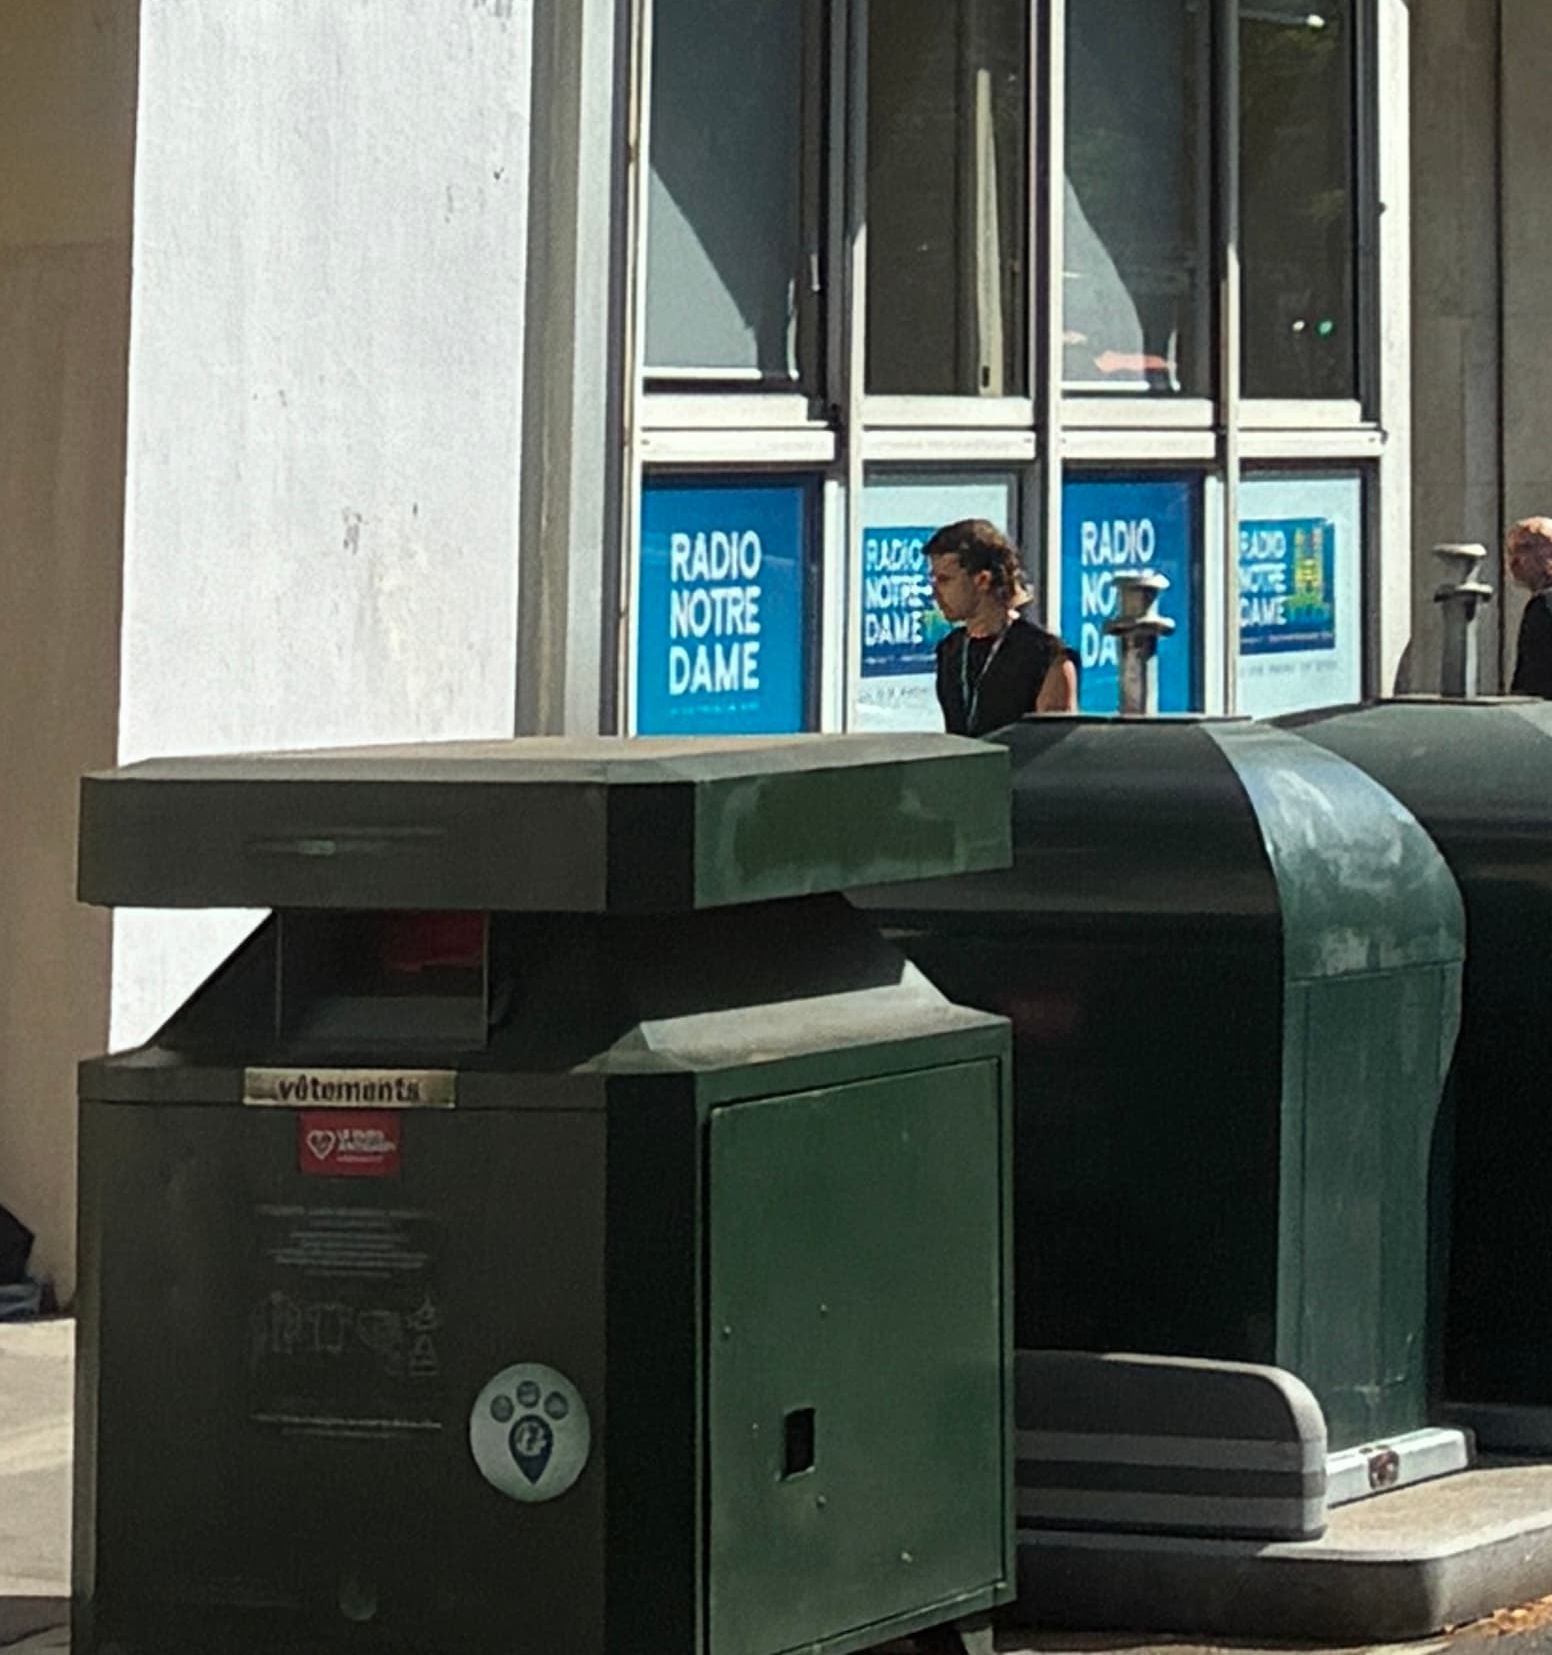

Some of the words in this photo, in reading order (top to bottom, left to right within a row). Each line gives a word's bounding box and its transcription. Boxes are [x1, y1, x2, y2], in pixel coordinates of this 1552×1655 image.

[671, 530, 762, 582] RADIO
[866, 538, 924, 572] RADIO
[1081, 518, 1156, 566] RADIO
[670, 585, 761, 639] NOTRE
[865, 611, 923, 647] DAME
[669, 641, 760, 695] DAME
